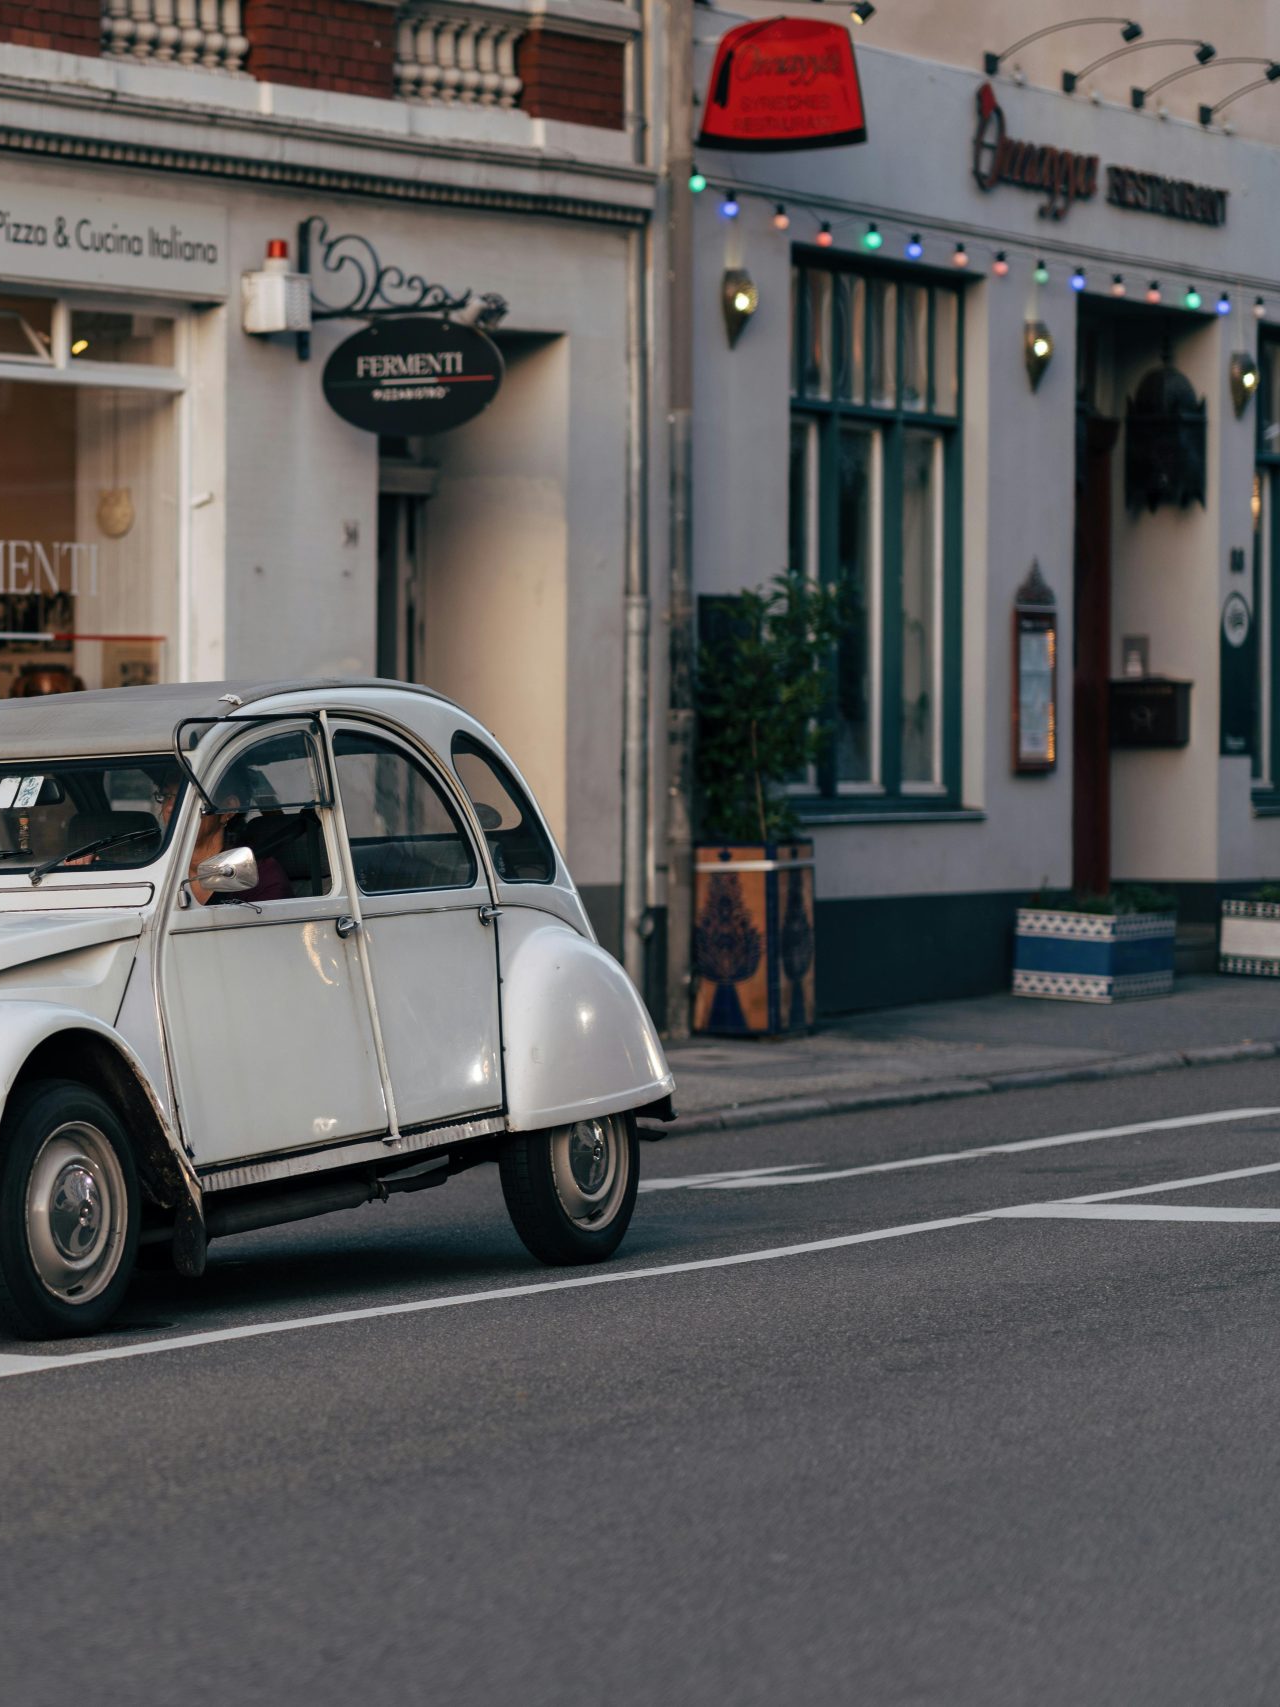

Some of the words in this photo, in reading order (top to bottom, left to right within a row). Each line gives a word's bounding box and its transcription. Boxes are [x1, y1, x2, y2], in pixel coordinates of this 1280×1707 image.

[53, 216, 69, 248] &
[75, 219, 143, 256] Cucina
[148, 225, 218, 264] Italiana
[356, 351, 464, 378] FERMENTI
